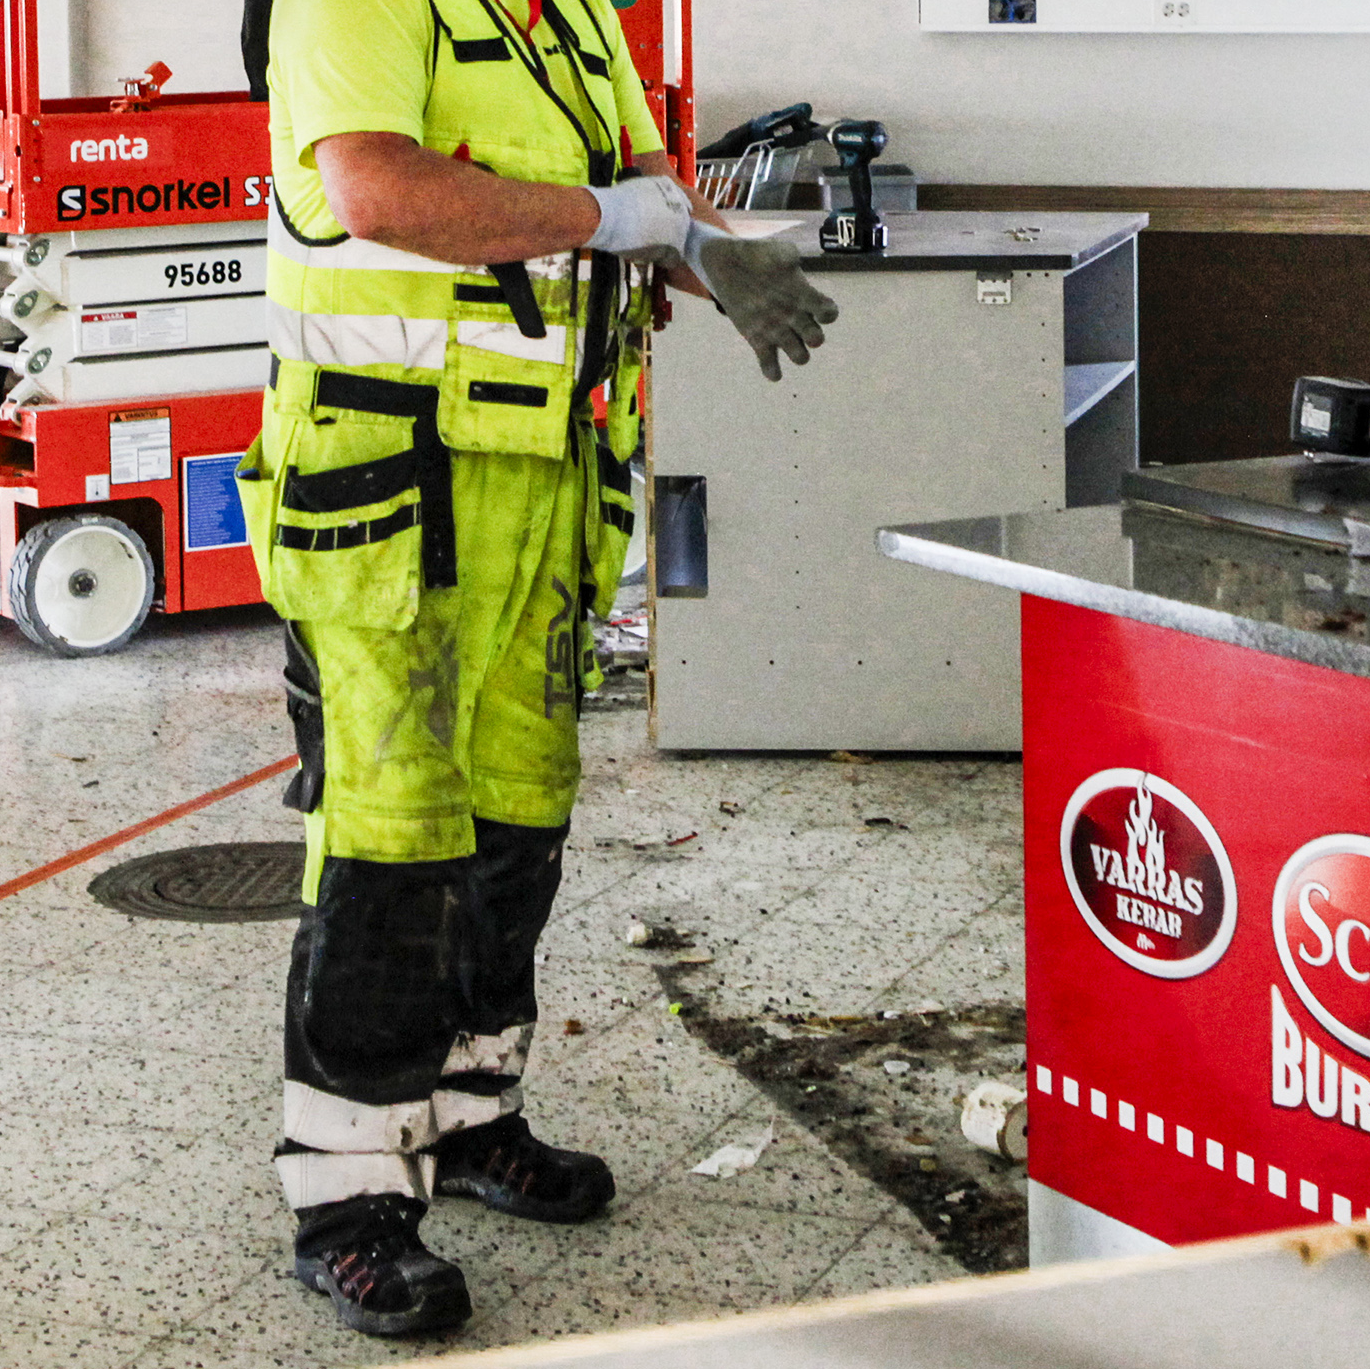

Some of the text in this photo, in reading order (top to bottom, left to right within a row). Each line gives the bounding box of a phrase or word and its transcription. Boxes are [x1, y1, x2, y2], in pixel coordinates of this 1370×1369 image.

[70, 134, 149, 163] renta
[90, 177, 230, 216] snorkel
[164, 260, 243, 289] 95688
[1090, 825, 1204, 917] VARRAS
[1116, 893, 1183, 940] KEBAB
